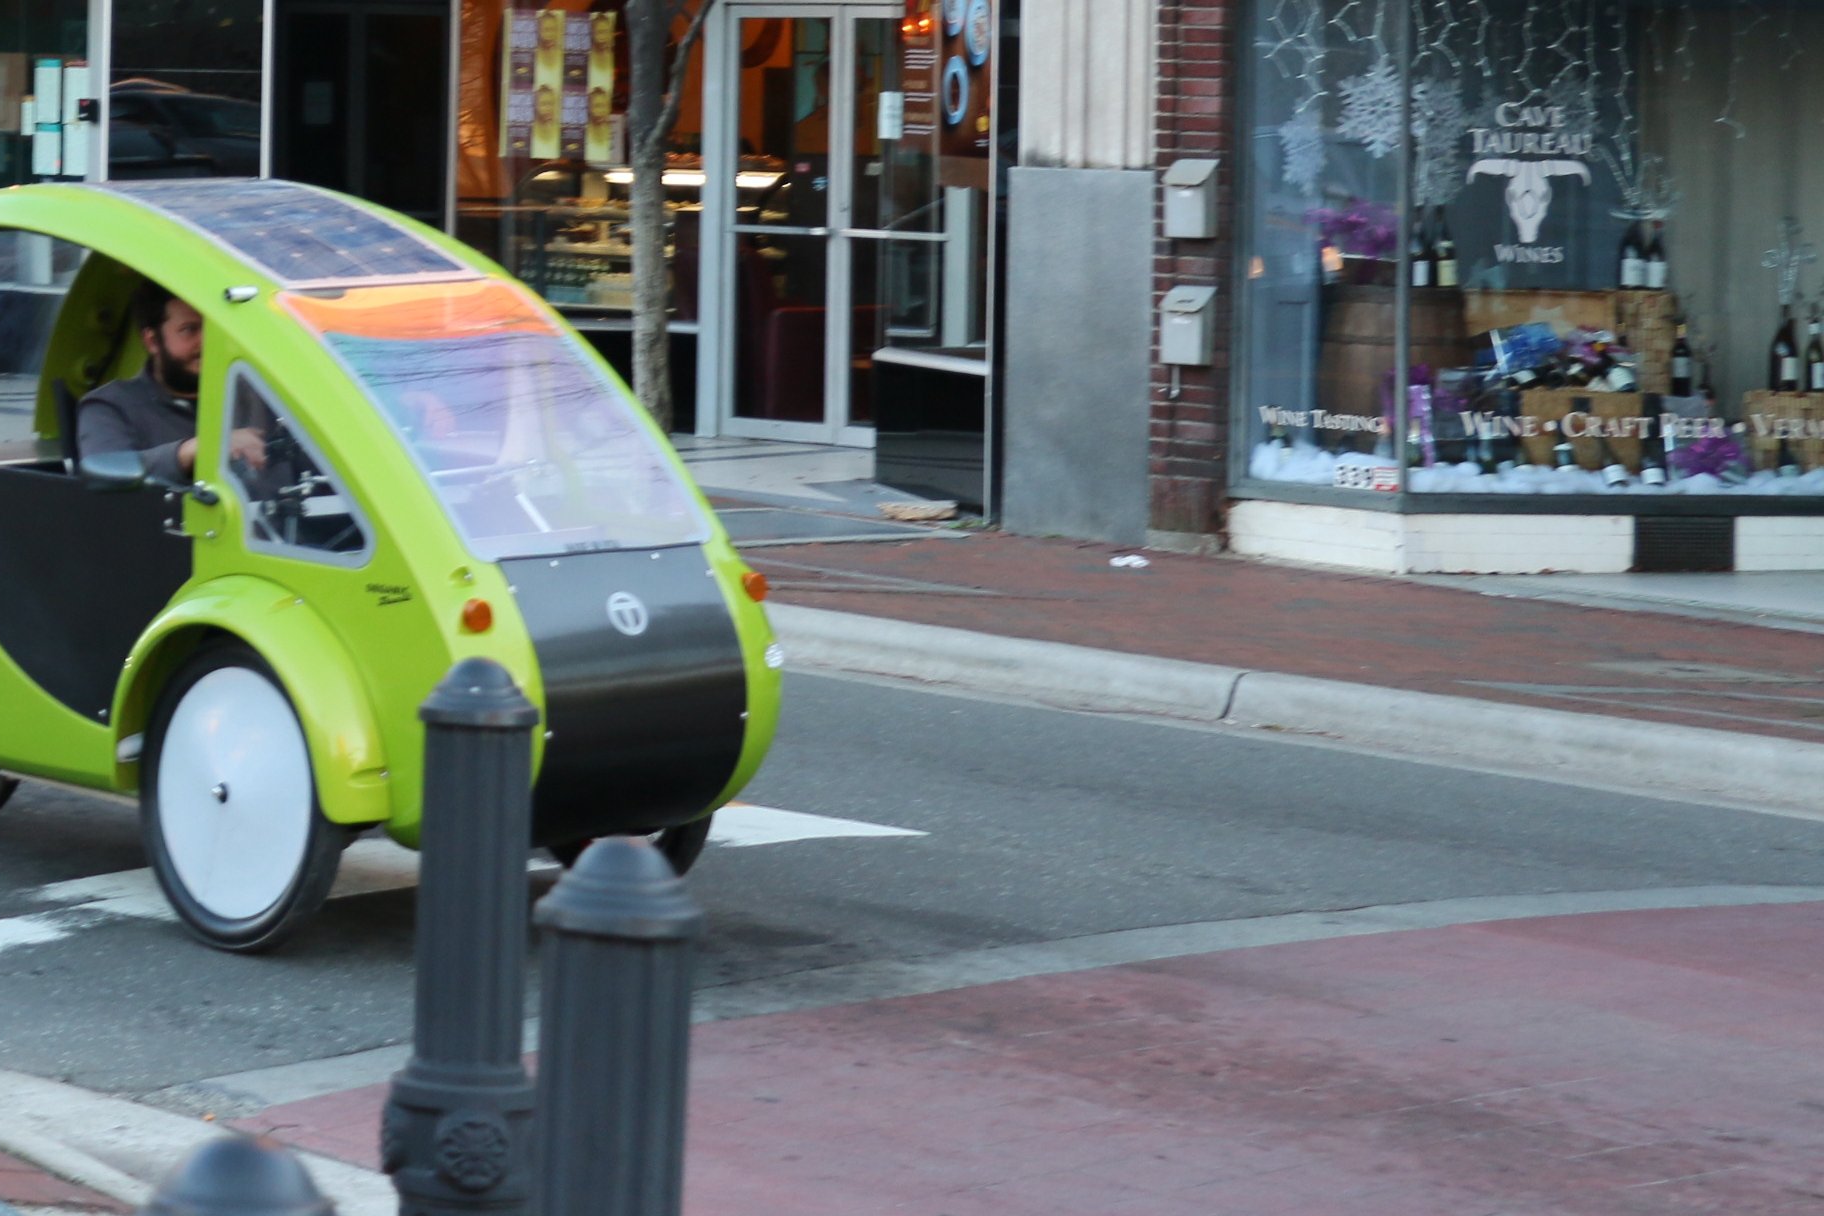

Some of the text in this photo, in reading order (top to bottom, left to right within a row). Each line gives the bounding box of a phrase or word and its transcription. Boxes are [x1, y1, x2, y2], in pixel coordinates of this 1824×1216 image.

[1494, 101, 1567, 127] CAVE
[1466, 128, 1593, 155] TAUREAU
[1493, 244, 1564, 264] WINES
[1258, 405, 1386, 433] WINE TASTING
[1459, 409, 1540, 438] WINE
[1560, 411, 1654, 438] CRAFT
[1659, 412, 1727, 438] BEER
